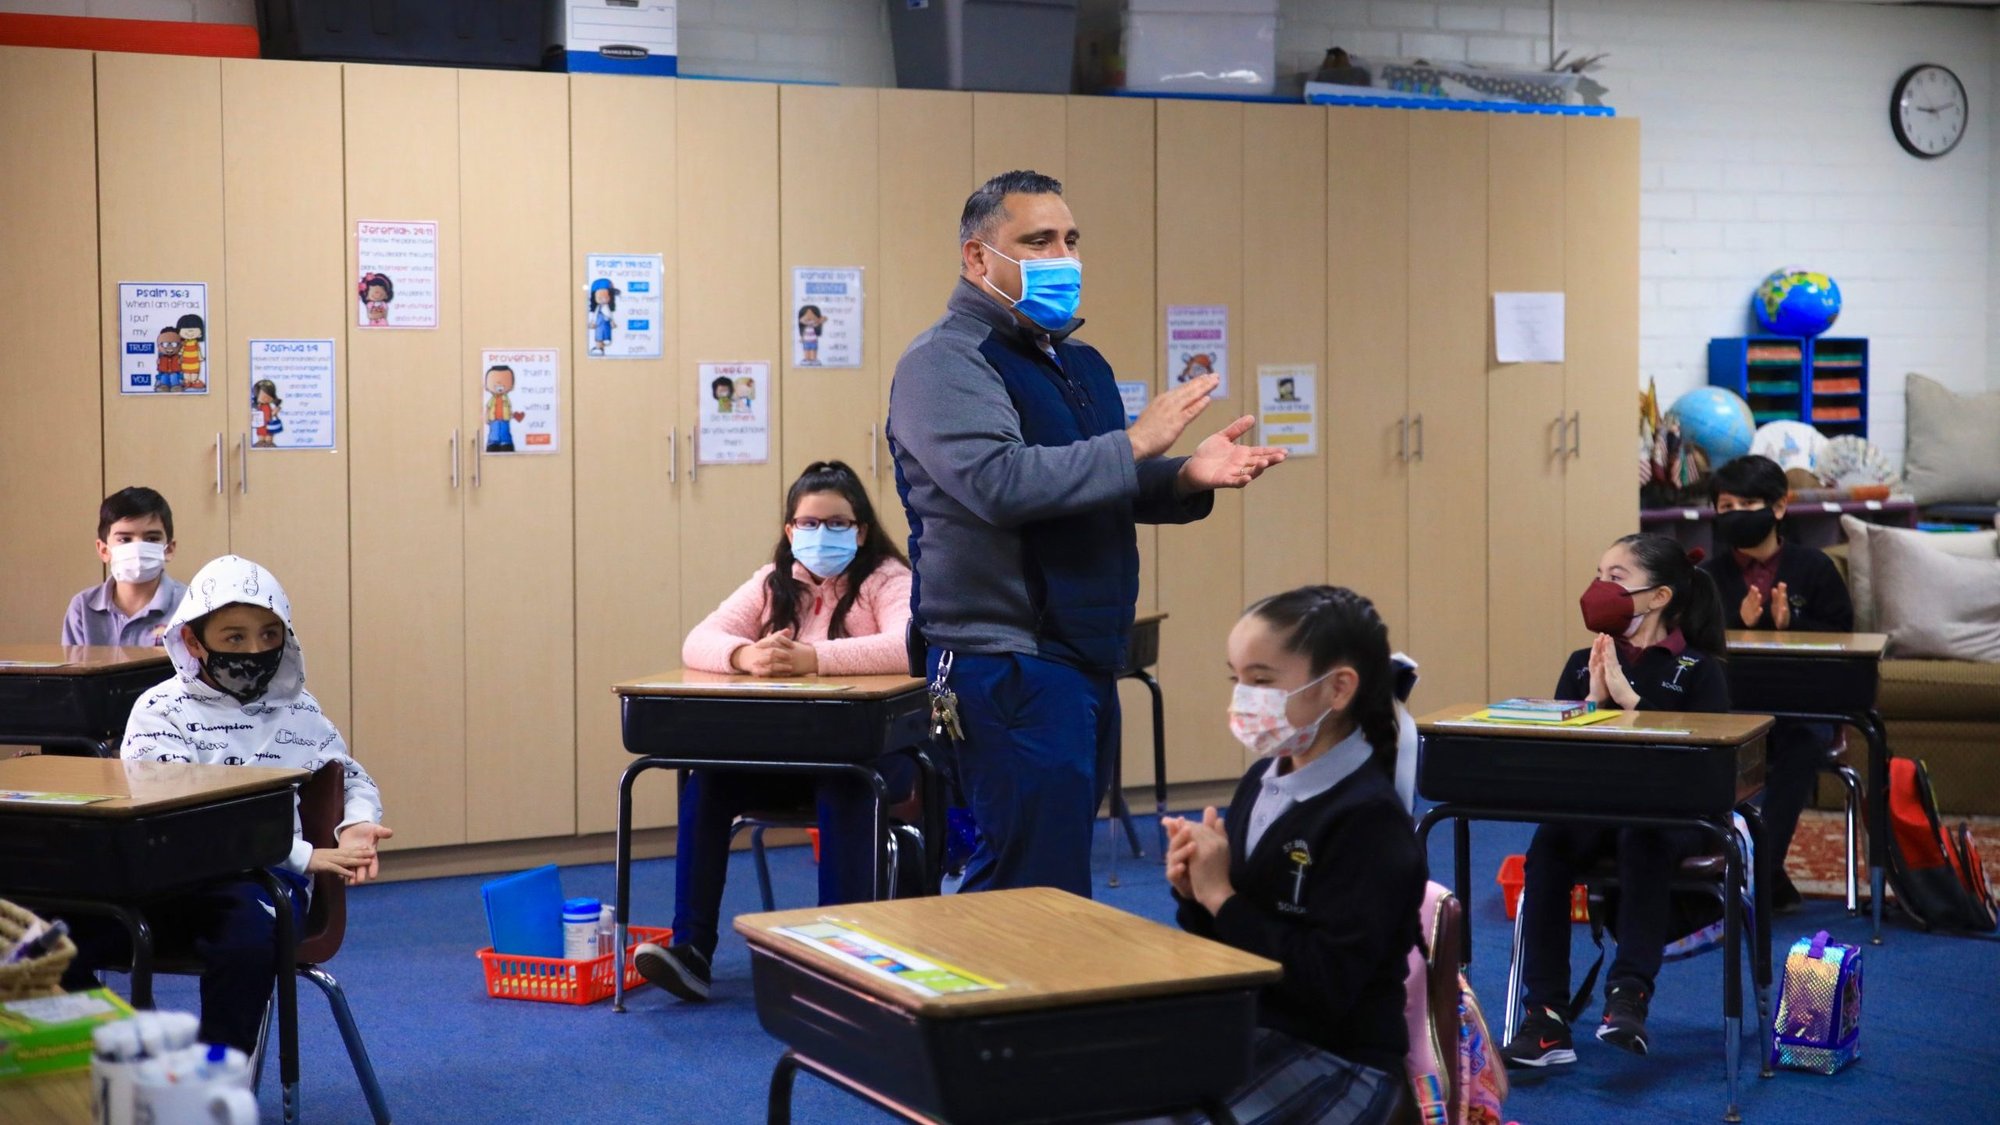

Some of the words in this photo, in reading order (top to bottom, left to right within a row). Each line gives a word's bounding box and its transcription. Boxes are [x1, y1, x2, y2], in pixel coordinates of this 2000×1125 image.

[136, 288, 168, 298] Psalm
[170, 290, 190, 298] 56:3
[126, 300, 150, 308] When
[134, 314, 149, 322] put
[128, 344, 152, 352] TRUST
[186, 722, 254, 734] Champion
